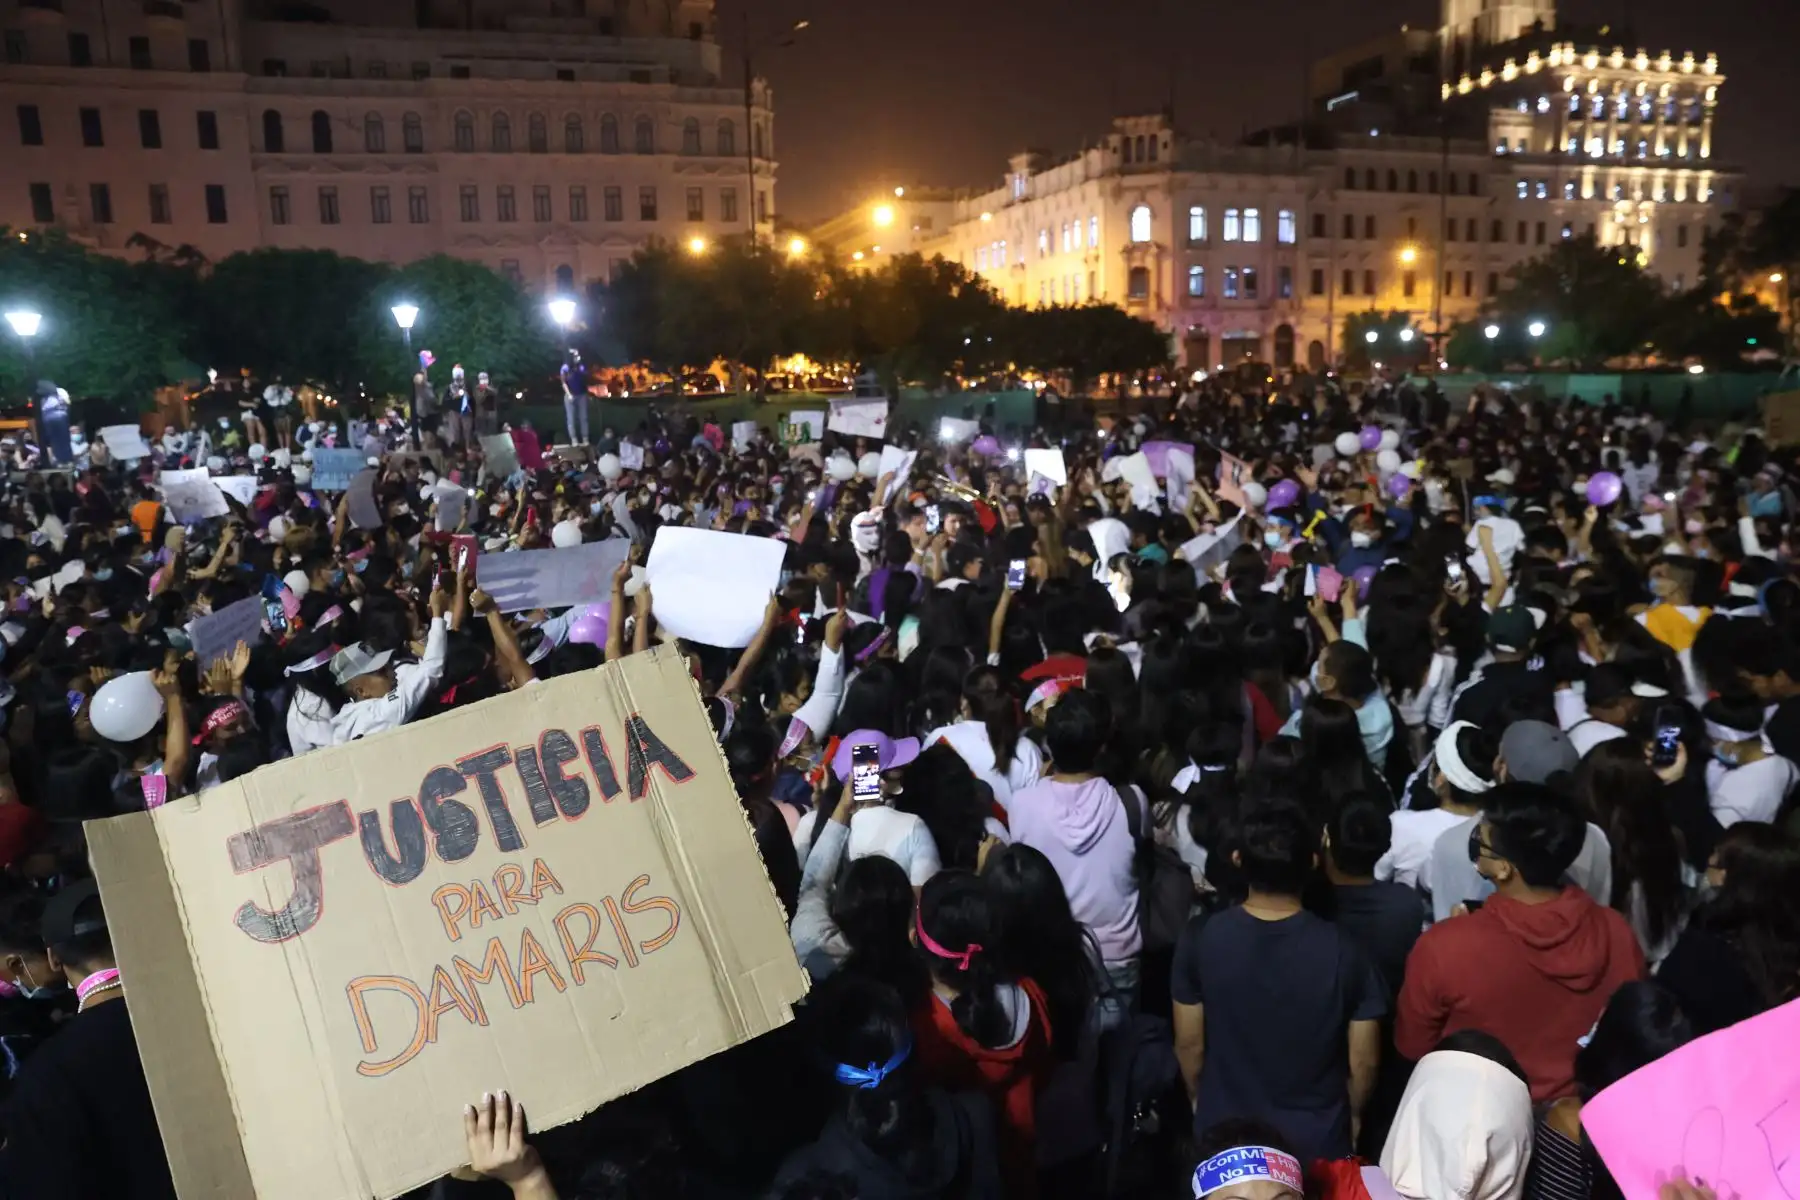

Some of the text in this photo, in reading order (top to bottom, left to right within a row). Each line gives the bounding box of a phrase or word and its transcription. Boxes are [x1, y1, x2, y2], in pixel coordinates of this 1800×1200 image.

[227, 712, 697, 944] JUSTICIA
[431, 857, 564, 942] PARA
[346, 873, 681, 1077] DAMARIS
